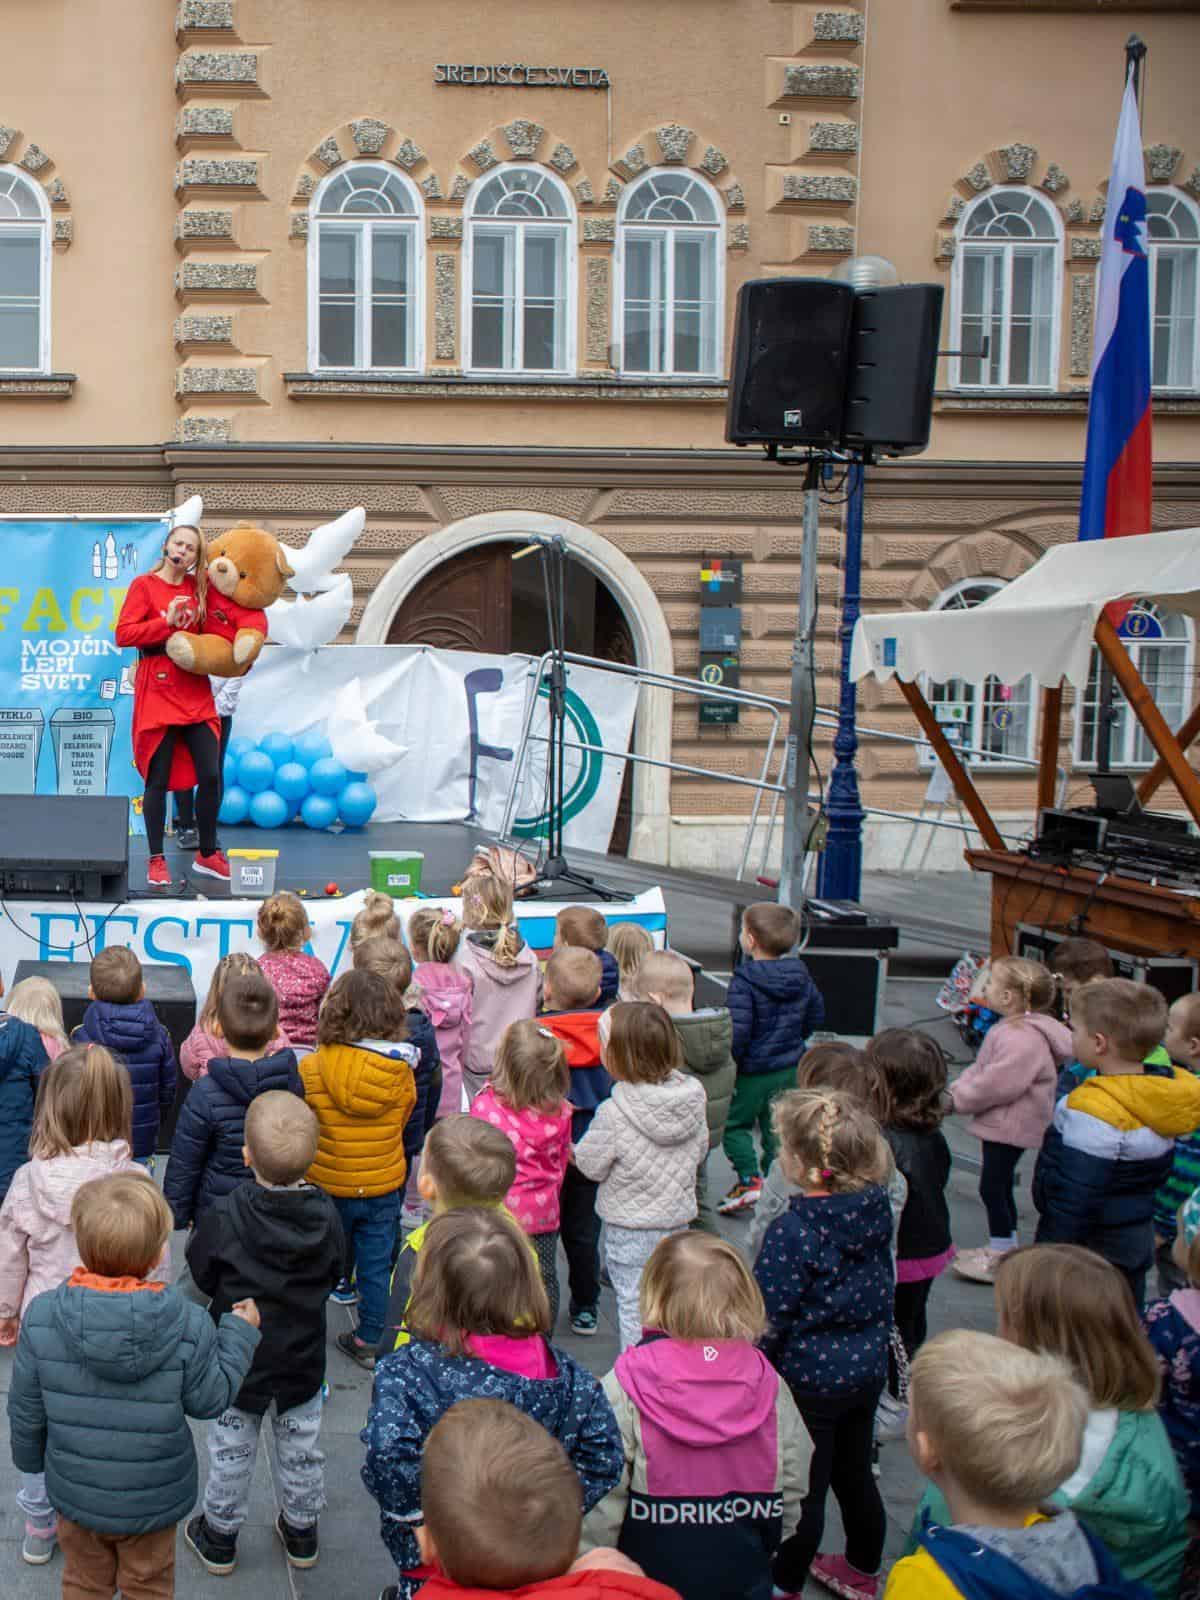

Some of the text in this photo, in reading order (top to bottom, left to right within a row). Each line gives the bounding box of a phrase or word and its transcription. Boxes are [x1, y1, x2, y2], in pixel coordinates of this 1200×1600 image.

[544, 65, 610, 88] SVETA
[21, 634, 122, 656] MOJČIN
[21, 655, 75, 674] LEPI
[21, 673, 92, 691] SVET
[72, 712, 93, 720] BIO
[631, 1497, 784, 1524] DIDRIKSONS
